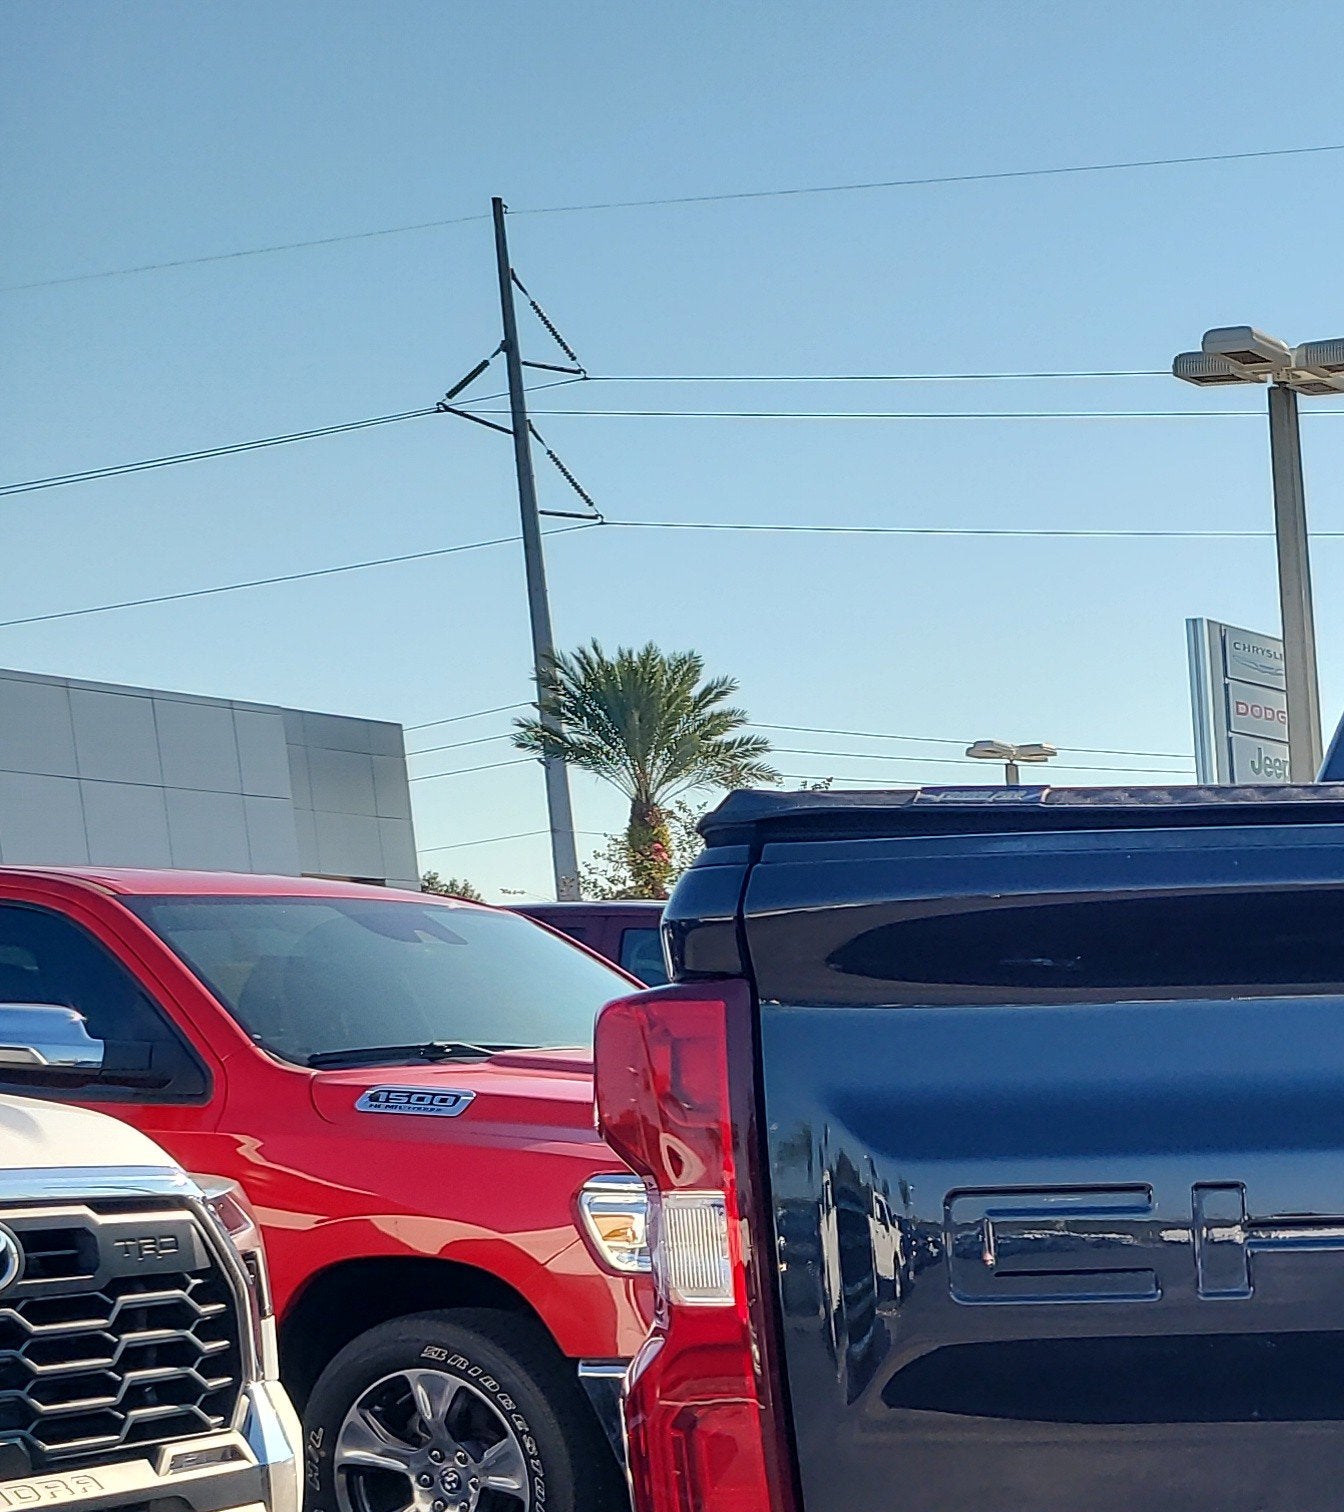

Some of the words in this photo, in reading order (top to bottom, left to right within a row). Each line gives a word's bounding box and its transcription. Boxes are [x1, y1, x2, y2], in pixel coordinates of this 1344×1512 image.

[1233, 641, 1284, 661] CHRYSL
[1235, 700, 1288, 725] DODG
[377, 1090, 457, 1106] 1500
[113, 1233, 179, 1262] TRD
[0, 1474, 105, 1506] DRA
